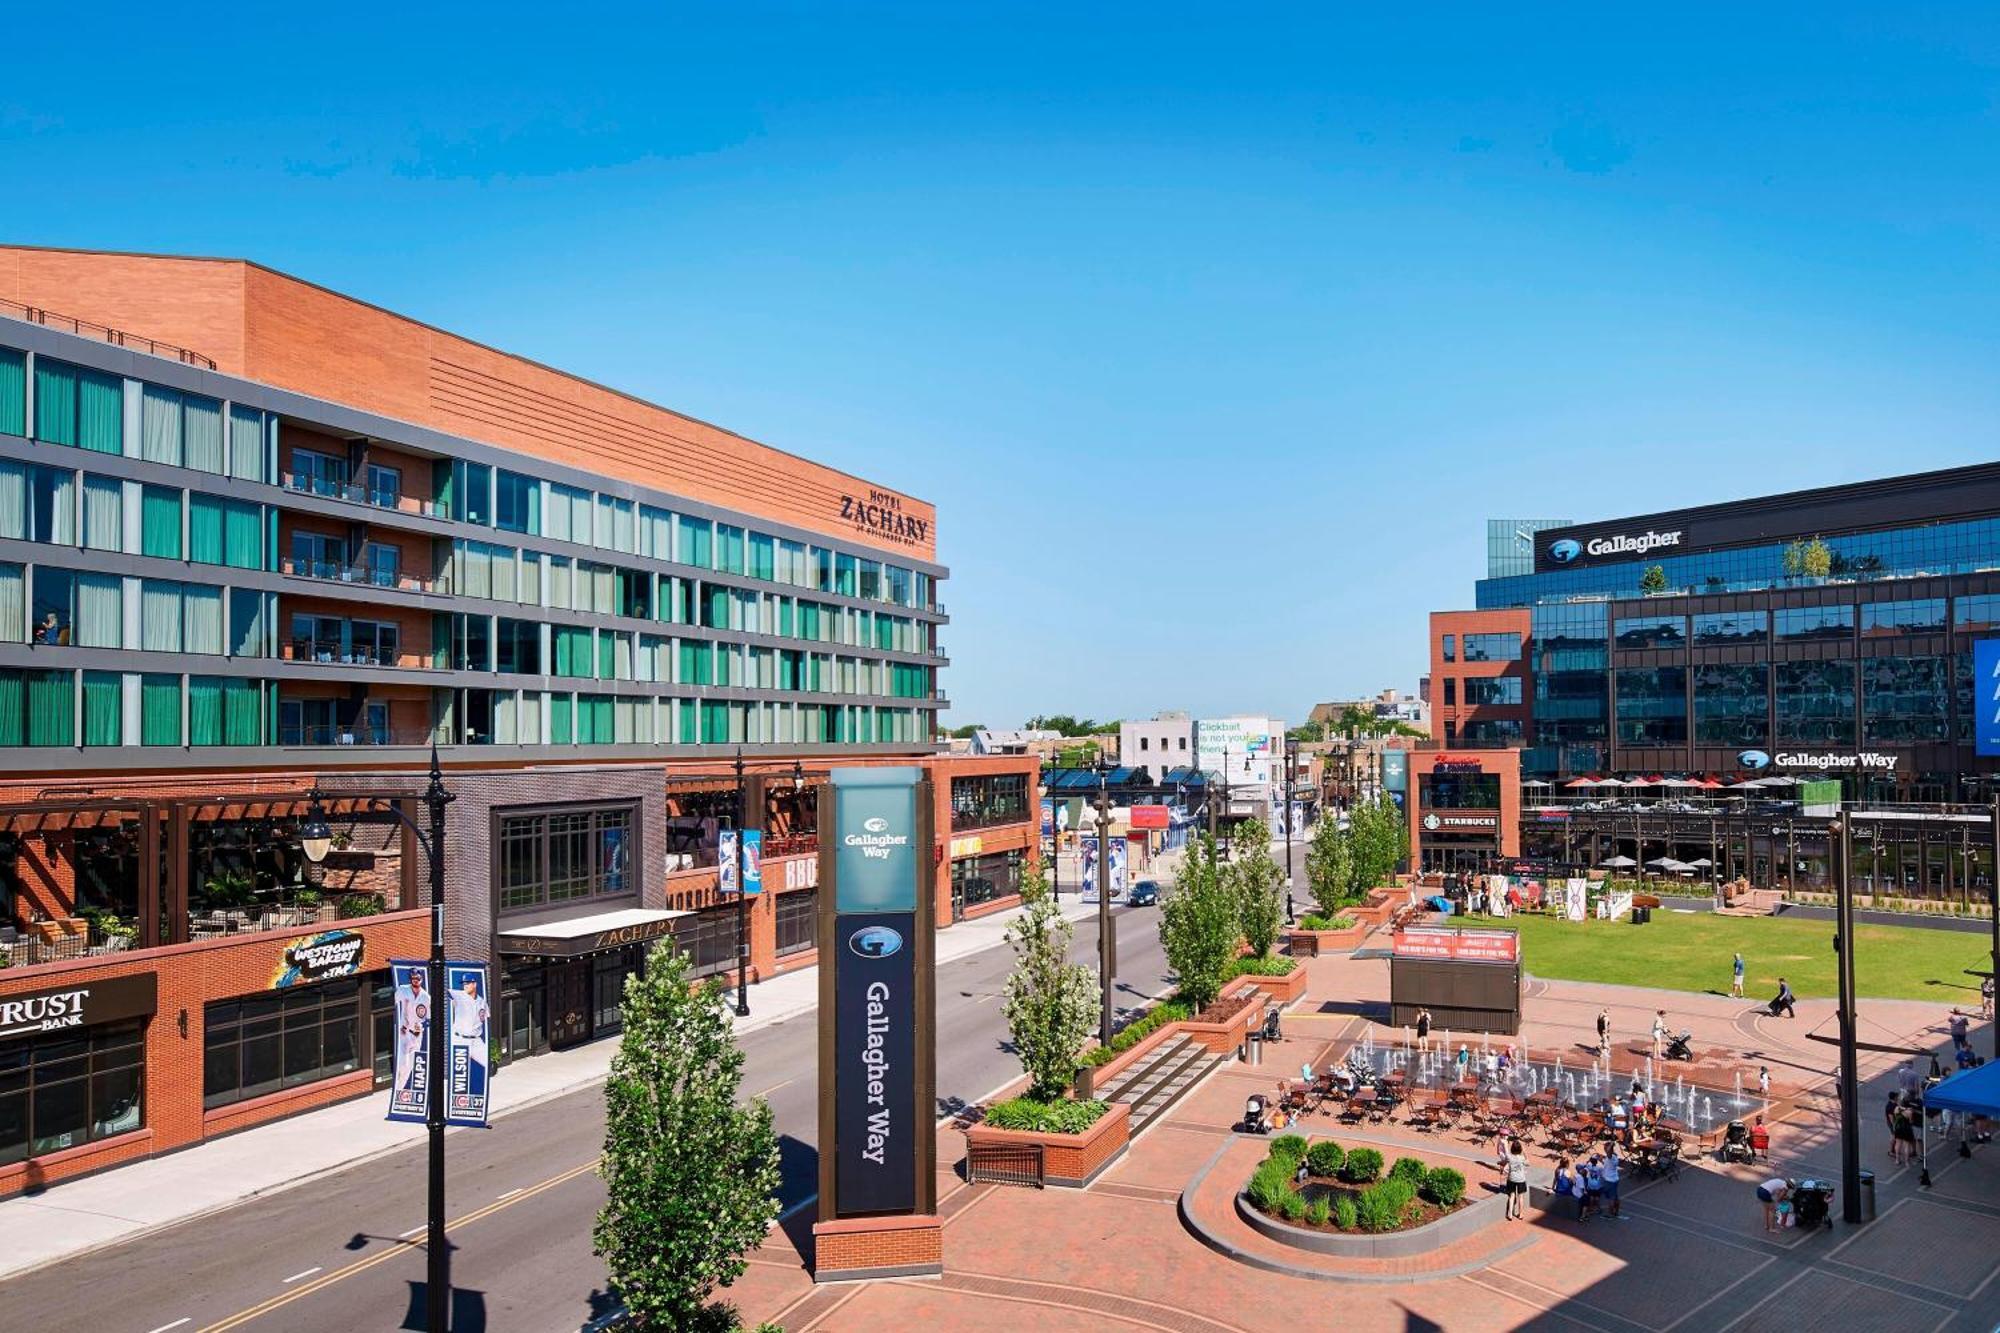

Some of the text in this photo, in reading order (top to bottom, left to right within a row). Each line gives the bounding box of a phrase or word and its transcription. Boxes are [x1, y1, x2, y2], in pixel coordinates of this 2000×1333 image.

[870, 490, 900, 509] HOTEL
[841, 495, 928, 541] ZACHARY
[1587, 530, 1681, 555] Gallagher
[1199, 723, 1240, 732] Clickbait
[1775, 753, 1858, 769] Gallagher
[1859, 753, 1897, 769] Way
[1444, 818, 1496, 826] STARBUCKS
[845, 834, 907, 847] Gallagher
[862, 846, 890, 859] Way
[785, 858, 817, 890] BBQ
[594, 919, 677, 948] ZACHARY
[308, 950, 355, 968] BAKERY
[0, 990, 89, 1025] RUST
[41, 1014, 83, 1031] BANK
[415, 1056, 426, 1088] HAPP
[454, 1048, 467, 1092] WILSON
[862, 981, 890, 1165] Gallagher Way
[417, 1094, 423, 1102] 8
